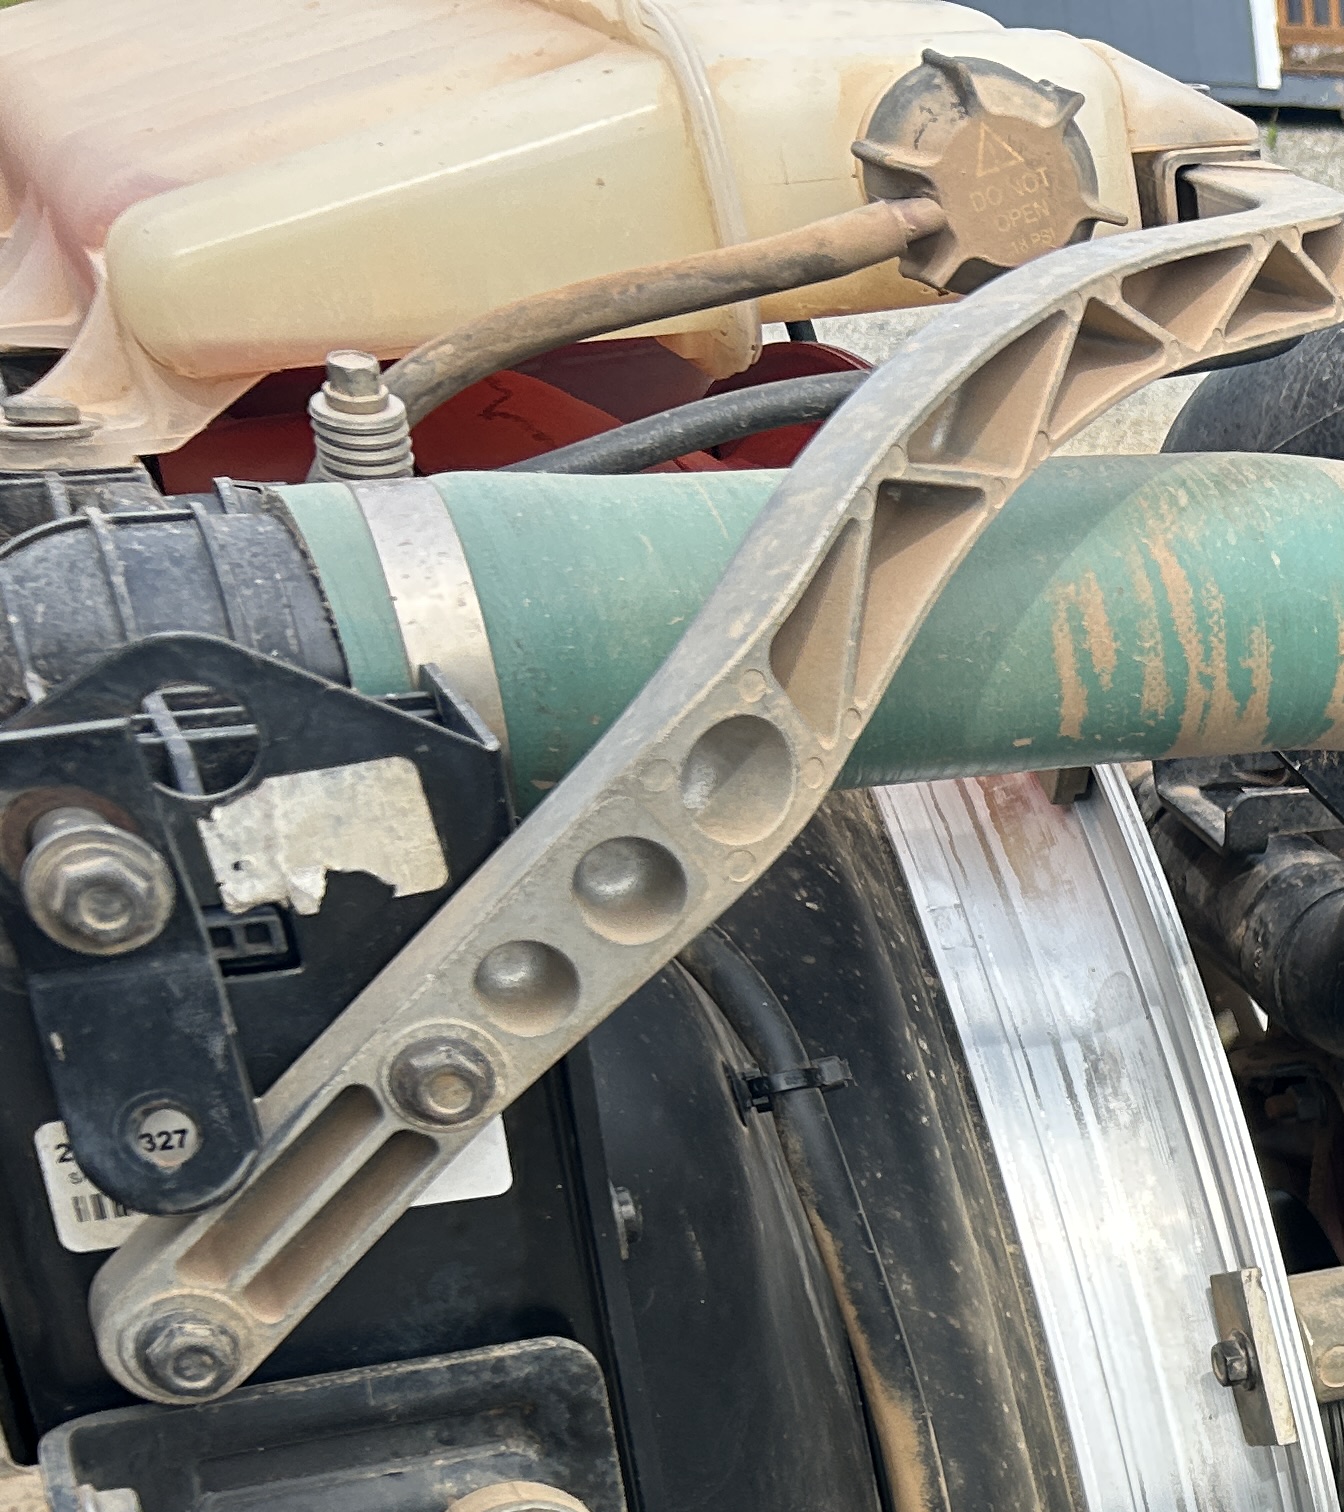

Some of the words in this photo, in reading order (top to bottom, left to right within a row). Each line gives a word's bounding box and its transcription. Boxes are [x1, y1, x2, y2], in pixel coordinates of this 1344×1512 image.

[969, 185, 1002, 213] DO
[1005, 167, 1050, 197] NOT
[998, 199, 1050, 232] OPEN
[138, 1127, 190, 1152] 327
